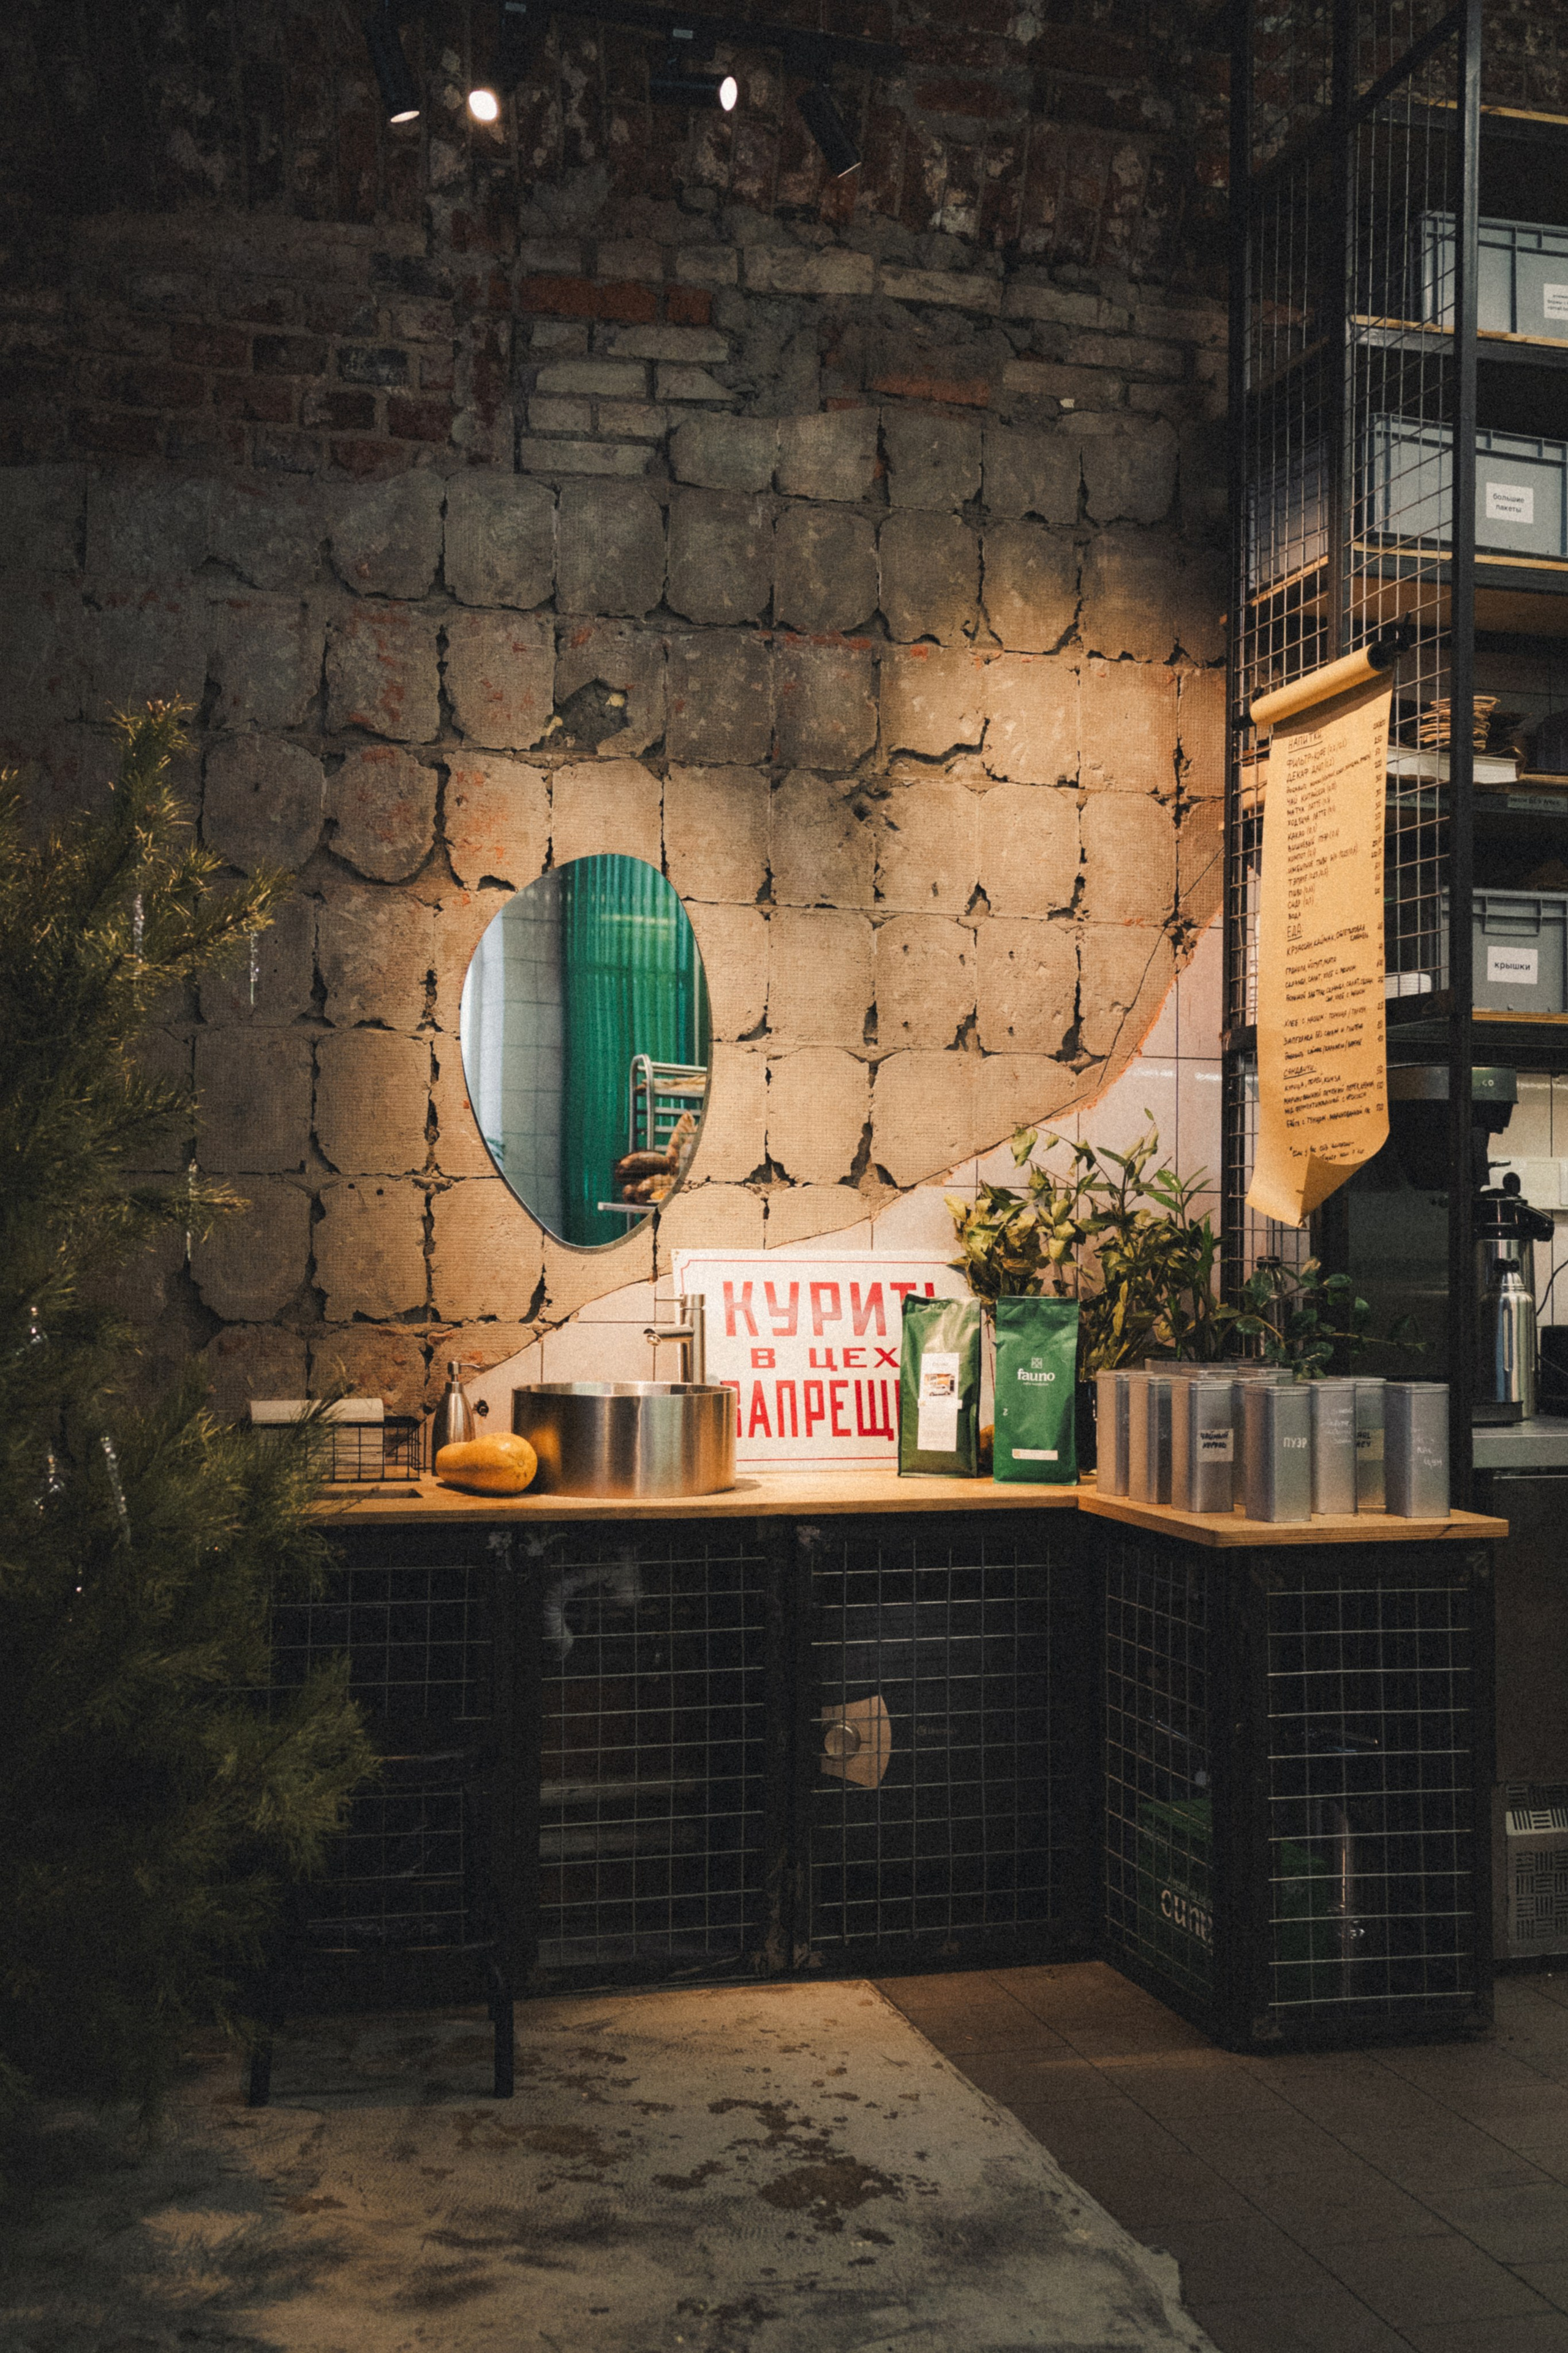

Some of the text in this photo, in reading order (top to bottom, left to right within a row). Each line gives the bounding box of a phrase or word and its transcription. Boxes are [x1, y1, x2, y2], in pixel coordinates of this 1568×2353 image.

[1493, 493, 1525, 504] большие
[1496, 504, 1521, 513] пакеты
[1494, 962, 1531, 970] крышки
[751, 1348, 775, 1369] В
[1017, 1368, 1055, 1381] fauno
[720, 1380, 901, 1441] АПРЕЩ
[1283, 1437, 1308, 1448] ПУЭР
